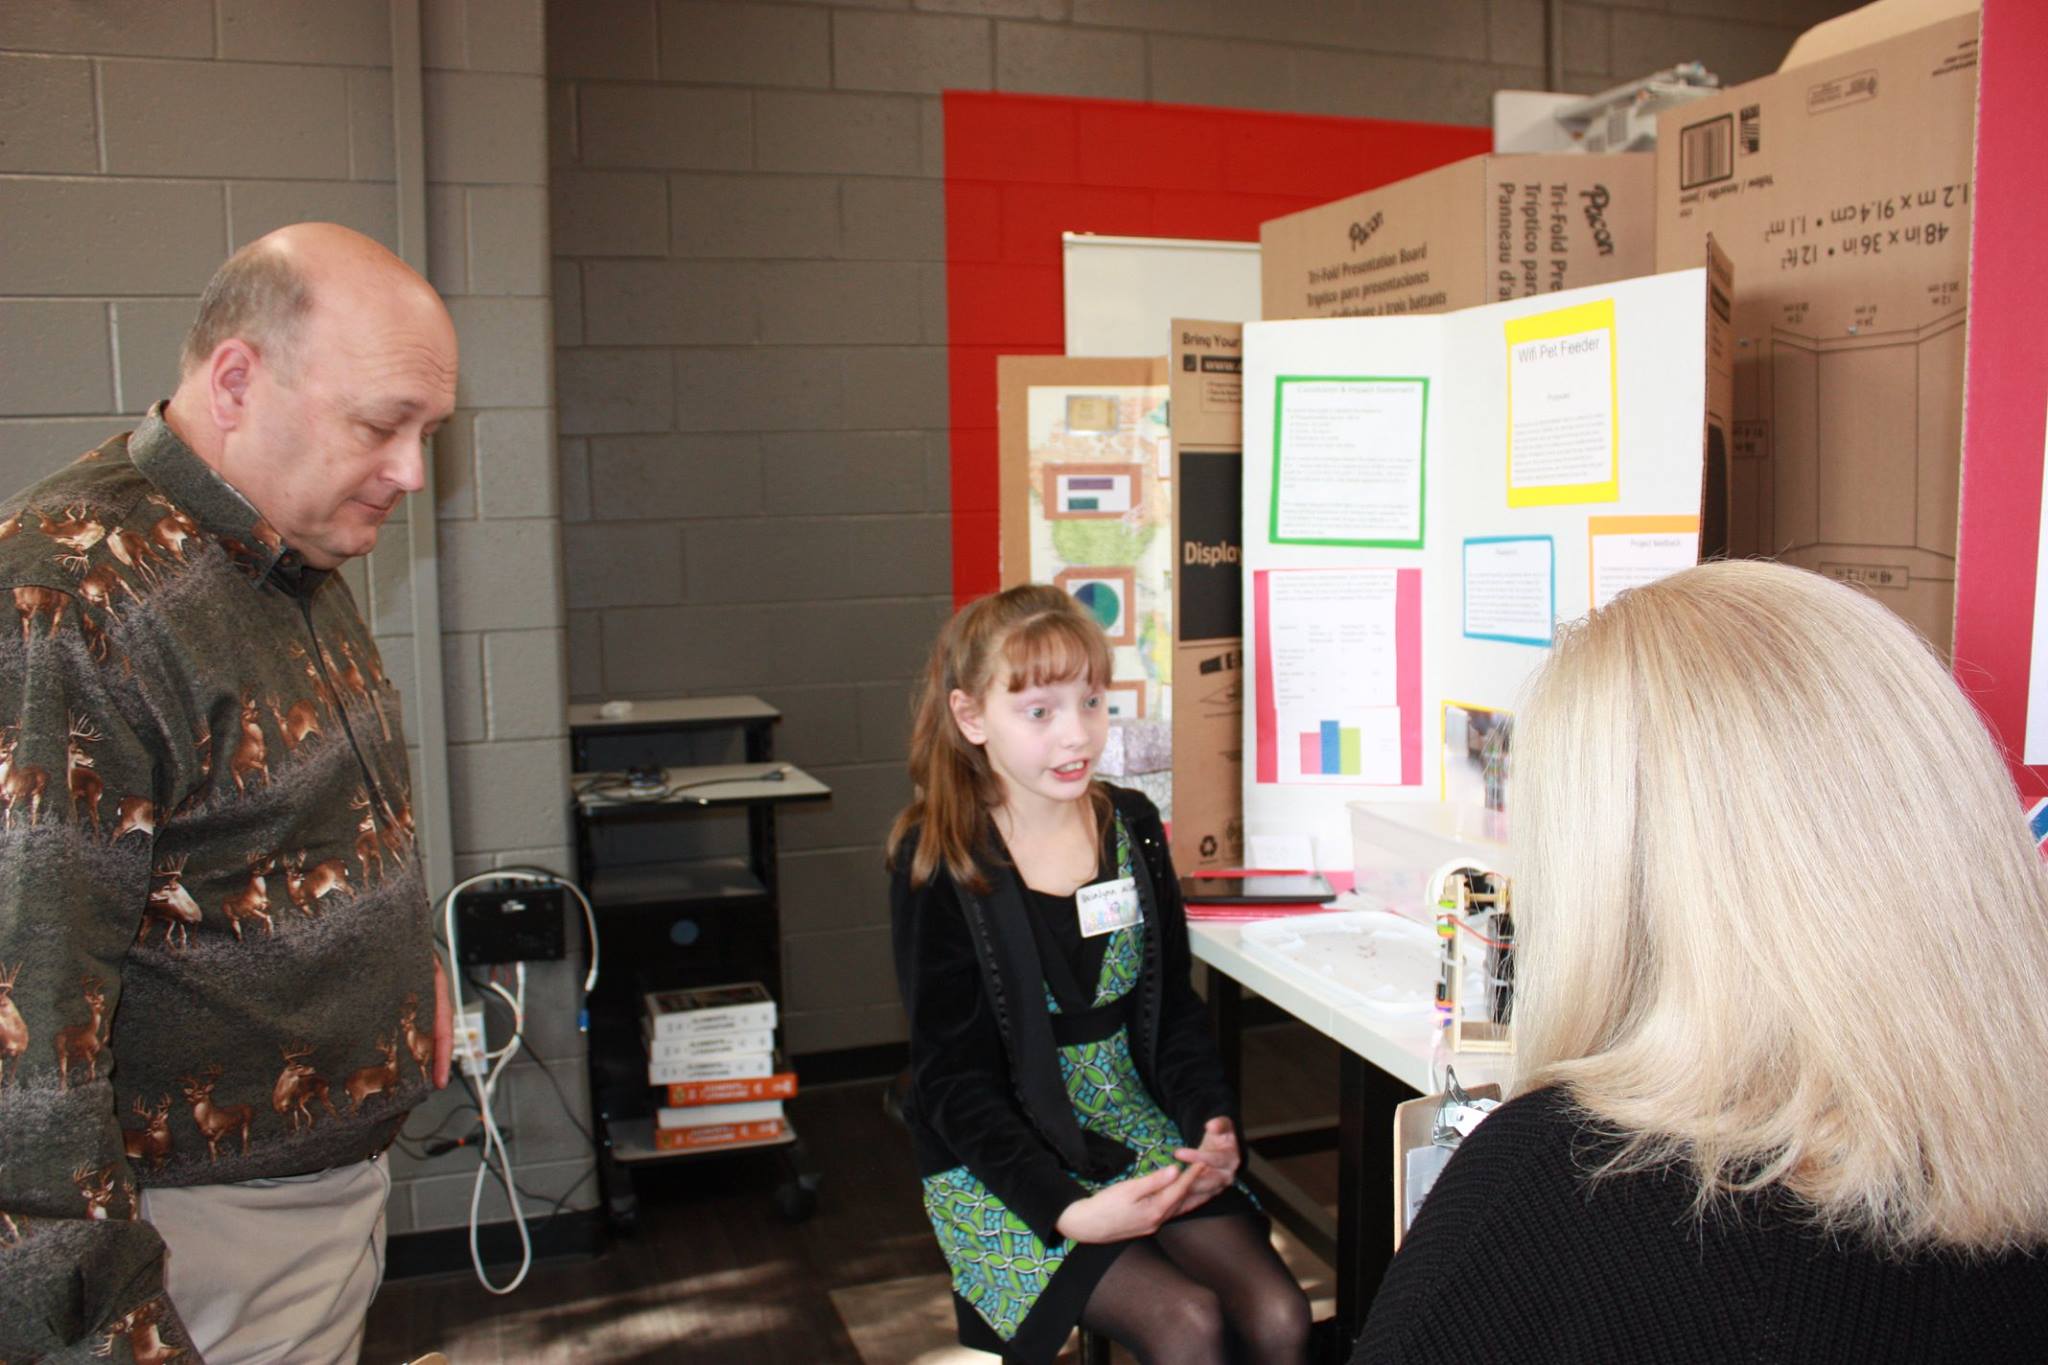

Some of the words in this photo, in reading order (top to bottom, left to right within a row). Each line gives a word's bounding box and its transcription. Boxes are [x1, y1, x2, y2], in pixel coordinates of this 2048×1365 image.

[1498, 182, 1516, 264] Panneau
[1550, 183, 1568, 253] Tri-Fold
[1400, 241, 1428, 263] Board
[1182, 332, 1211, 348] Bring
[1539, 342, 1558, 360] Pet
[1560, 336, 1600, 357] Feeder
